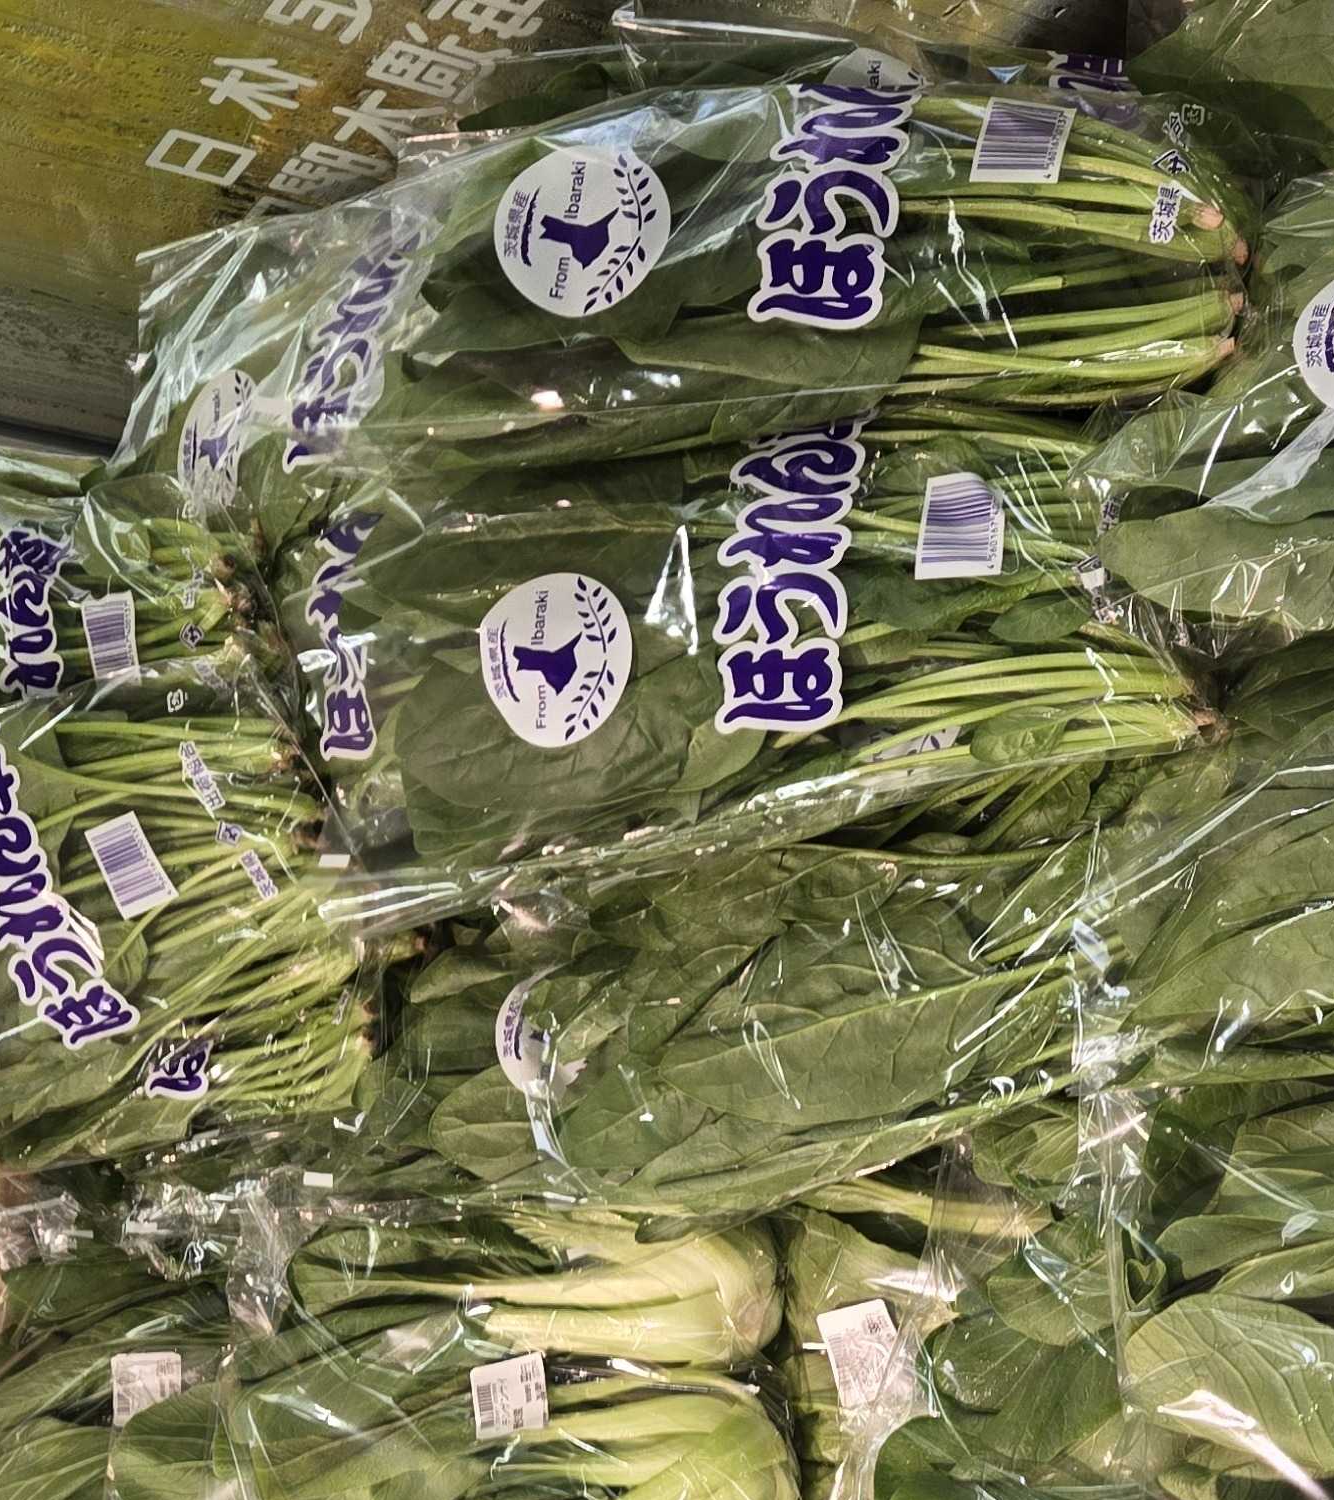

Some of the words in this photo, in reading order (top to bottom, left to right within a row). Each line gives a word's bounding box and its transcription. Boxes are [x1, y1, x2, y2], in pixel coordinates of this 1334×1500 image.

[549, 255, 572, 300] From
[563, 160, 590, 220] Ibaraki
[1306, 302, 1332, 367] 茨城県産
[720, 418, 860, 724] ほうれん
[529, 589, 552, 646] Ibaraki
[534, 684, 549, 730] From
